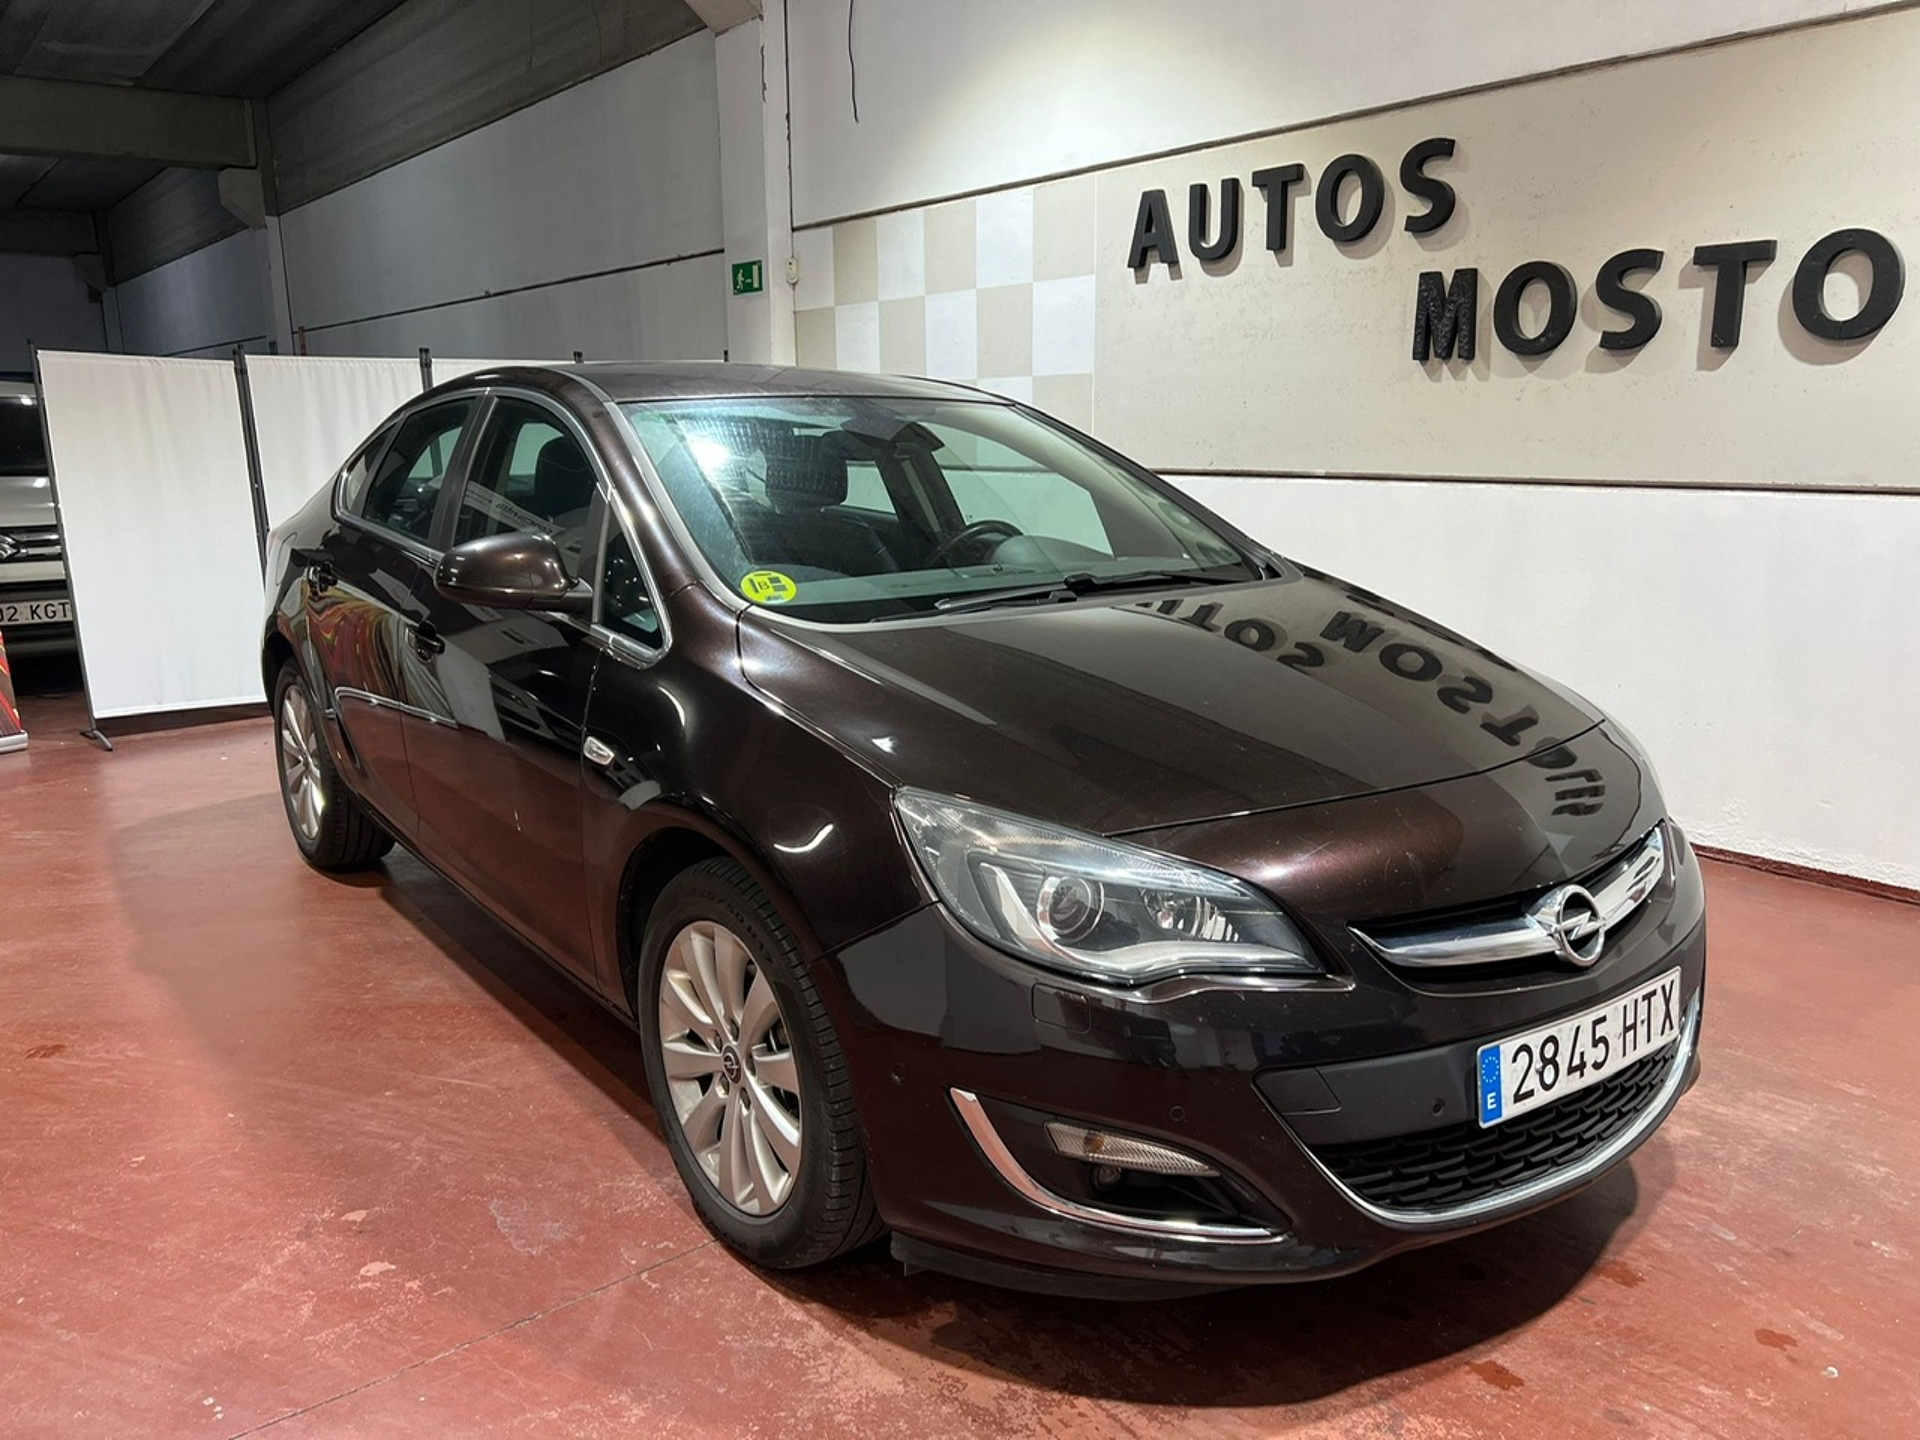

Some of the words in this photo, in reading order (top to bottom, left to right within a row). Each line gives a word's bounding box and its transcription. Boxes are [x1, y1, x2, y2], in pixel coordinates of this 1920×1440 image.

[1127, 137, 1456, 270] AUTOS
[1412, 228, 1905, 360] MOSTO
[29, 602, 70, 620] KGT
[1487, 1092, 1497, 1109] E
[1511, 1015, 1610, 1104] 2845
[1621, 979, 1675, 1058] HTX
